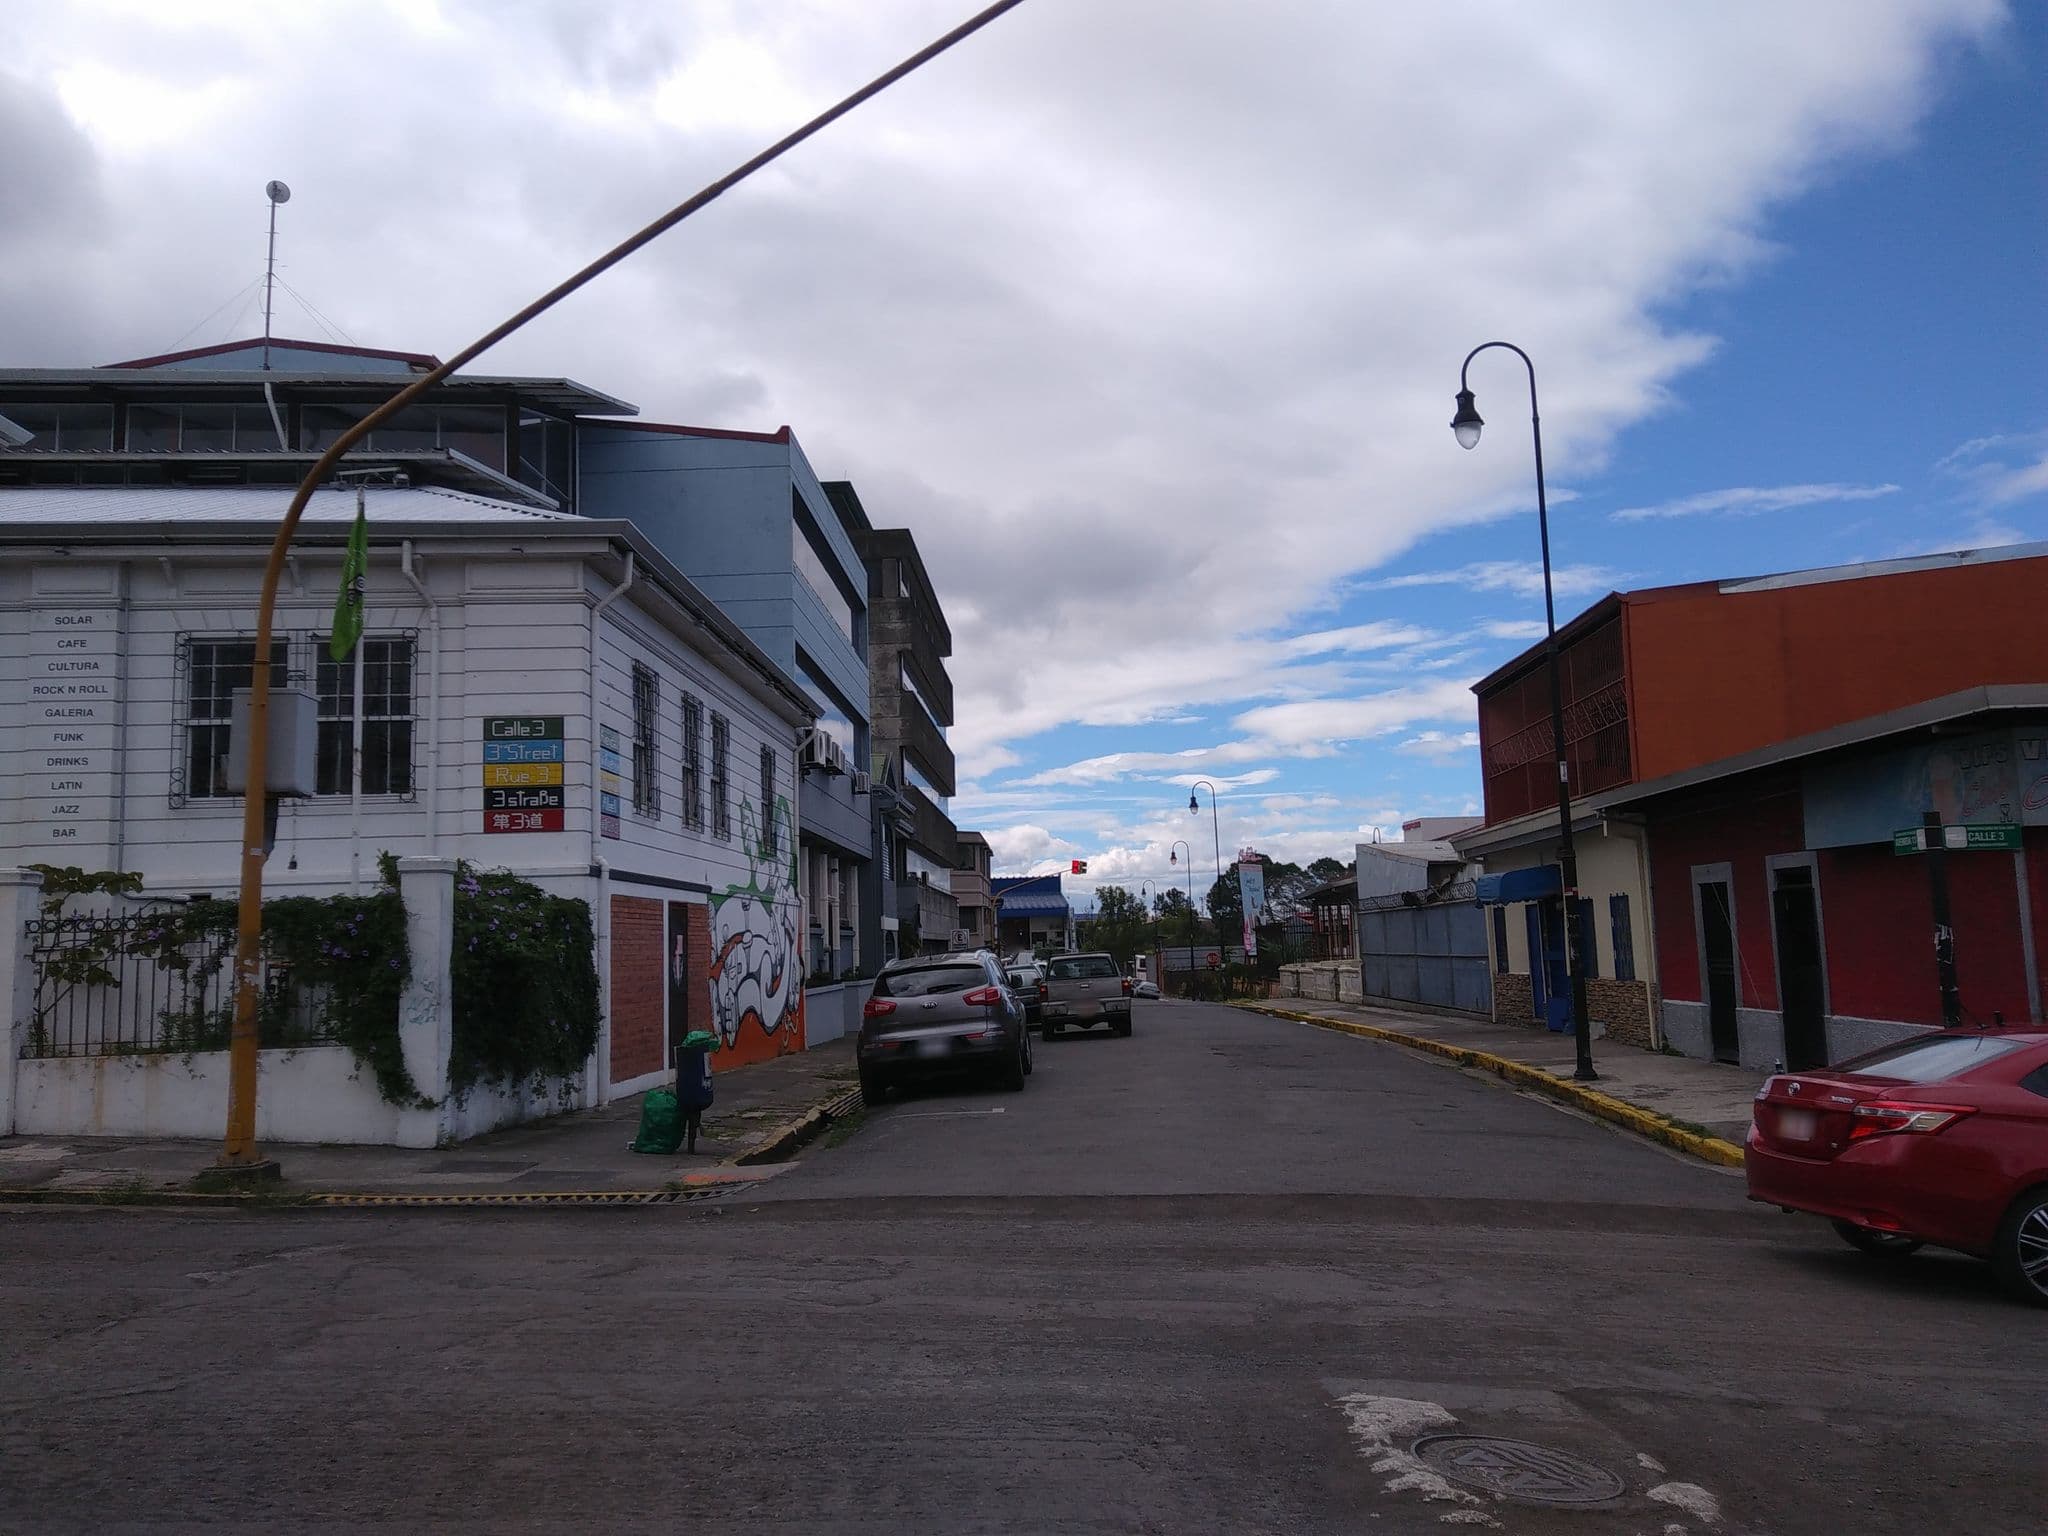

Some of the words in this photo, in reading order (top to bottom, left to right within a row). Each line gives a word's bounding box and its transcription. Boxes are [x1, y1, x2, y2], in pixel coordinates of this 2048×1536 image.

[54, 616, 92, 625] SOLAR
[57, 639, 87, 648] CAFE
[48, 662, 99, 671] CULTURA
[33, 685, 65, 695] ROCK
[68, 685, 76, 694] N
[79, 685, 108, 694] ROLL
[45, 708, 94, 718] GALERIA
[492, 720, 530, 737] Calle
[532, 720, 545, 737] 3
[54, 733, 84, 742] FUNK
[508, 743, 558, 761] Street
[47, 757, 89, 767] DRINKS
[496, 767, 530, 783] Rue
[536, 766, 549, 783] 3
[51, 781, 82, 790] LATIN
[492, 791, 505, 807] 3
[52, 805, 79, 815] JAZZ
[52, 829, 76, 838] BAR
[1968, 831, 1997, 842] CALLE
[1998, 831, 2005, 841] 3
